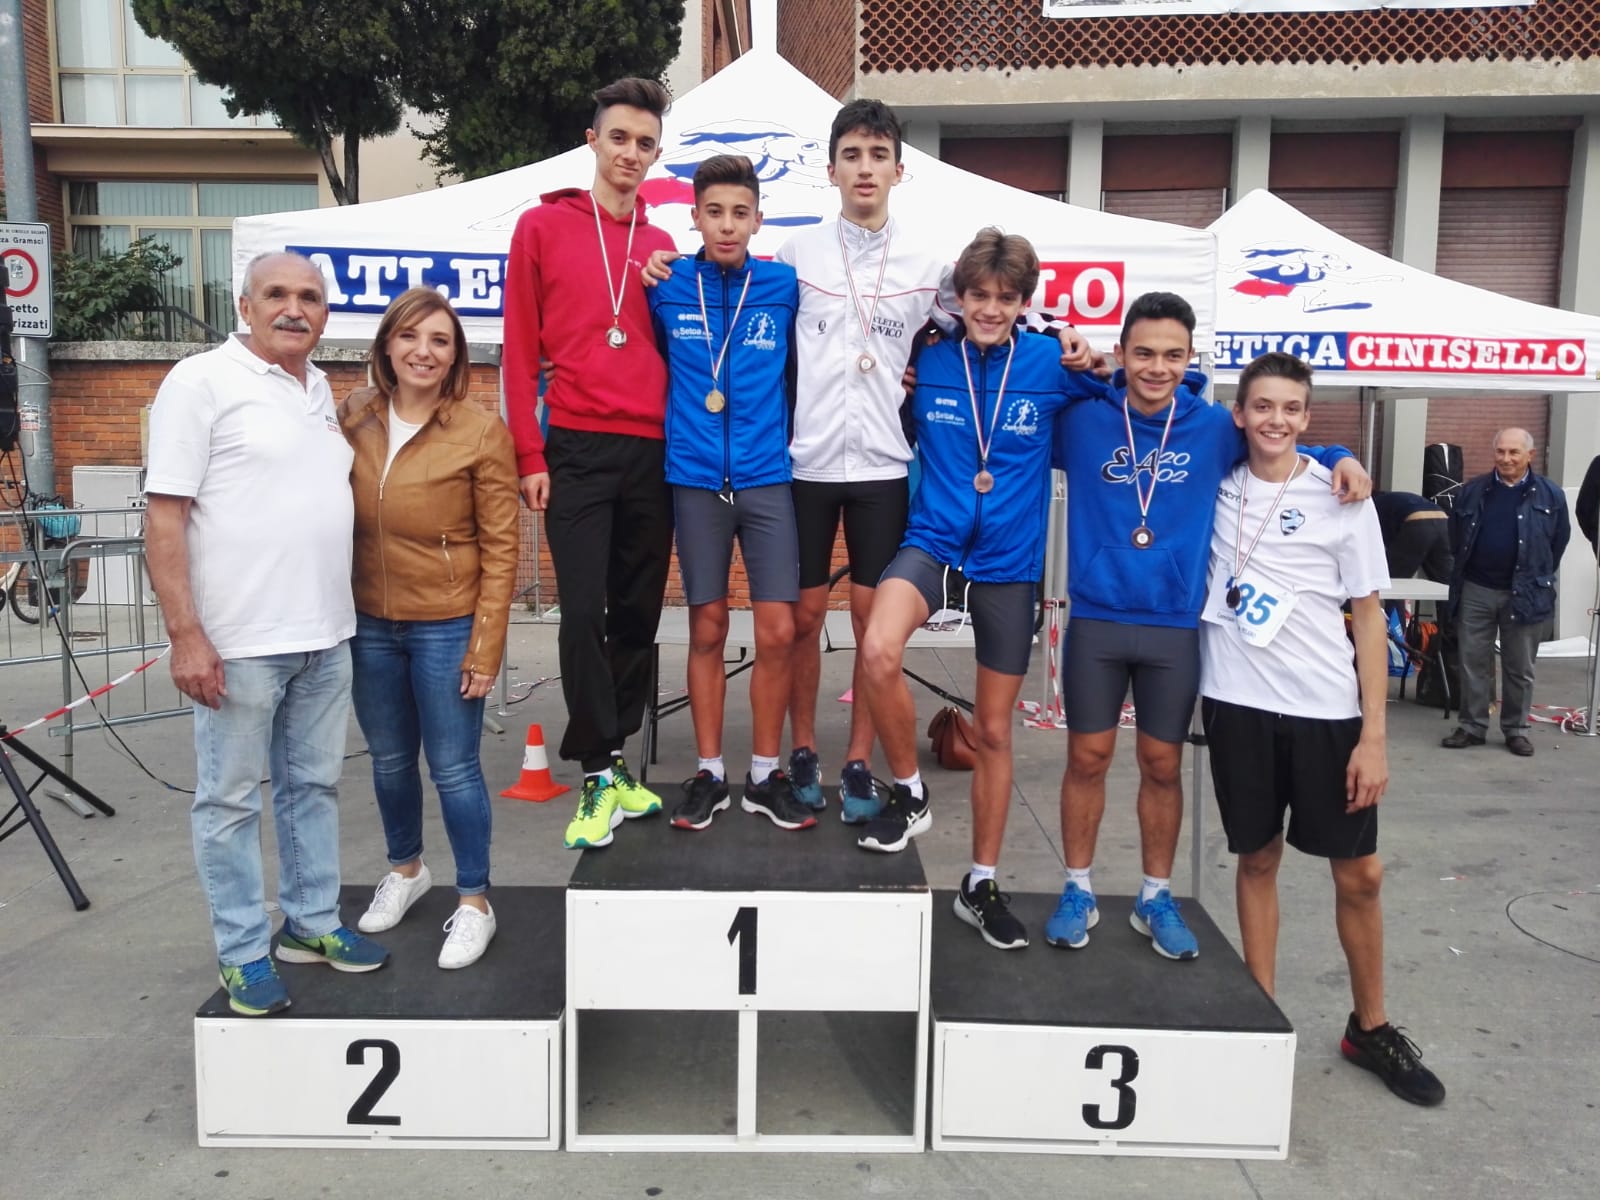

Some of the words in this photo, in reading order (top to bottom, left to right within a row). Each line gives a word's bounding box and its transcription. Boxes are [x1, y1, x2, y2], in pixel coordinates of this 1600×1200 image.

[13, 237, 44, 245] Gramsci
[309, 253, 508, 309] ATLE
[1349, 335, 1584, 371] CINISELLO
[728, 907, 757, 994] 1
[347, 1040, 400, 1125] 2
[1082, 1045, 1139, 1129] 3
